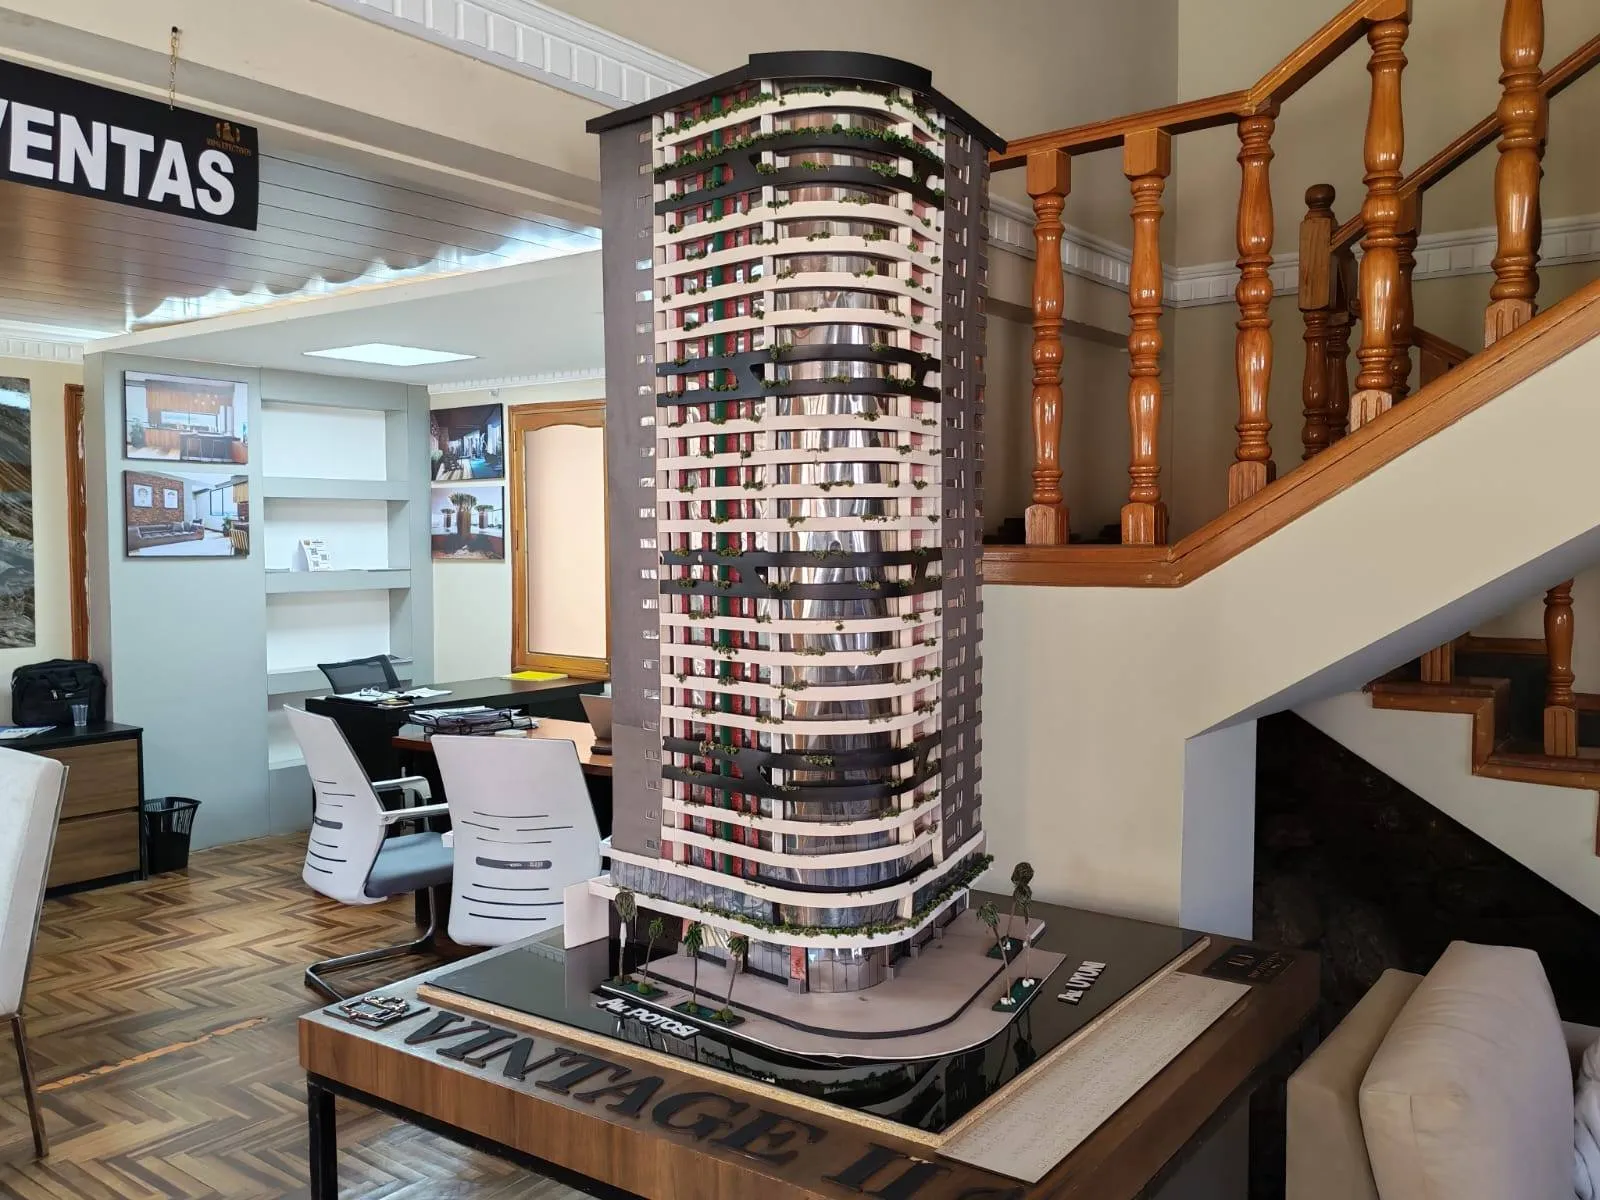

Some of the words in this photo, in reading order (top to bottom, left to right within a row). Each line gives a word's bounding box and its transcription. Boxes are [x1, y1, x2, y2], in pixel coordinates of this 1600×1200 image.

[0, 98, 235, 216] ENTAS
[1065, 960, 1107, 989] UYUNI
[624, 1008, 700, 1038] POTOSI
[404, 1010, 826, 1164] VINTAGE
